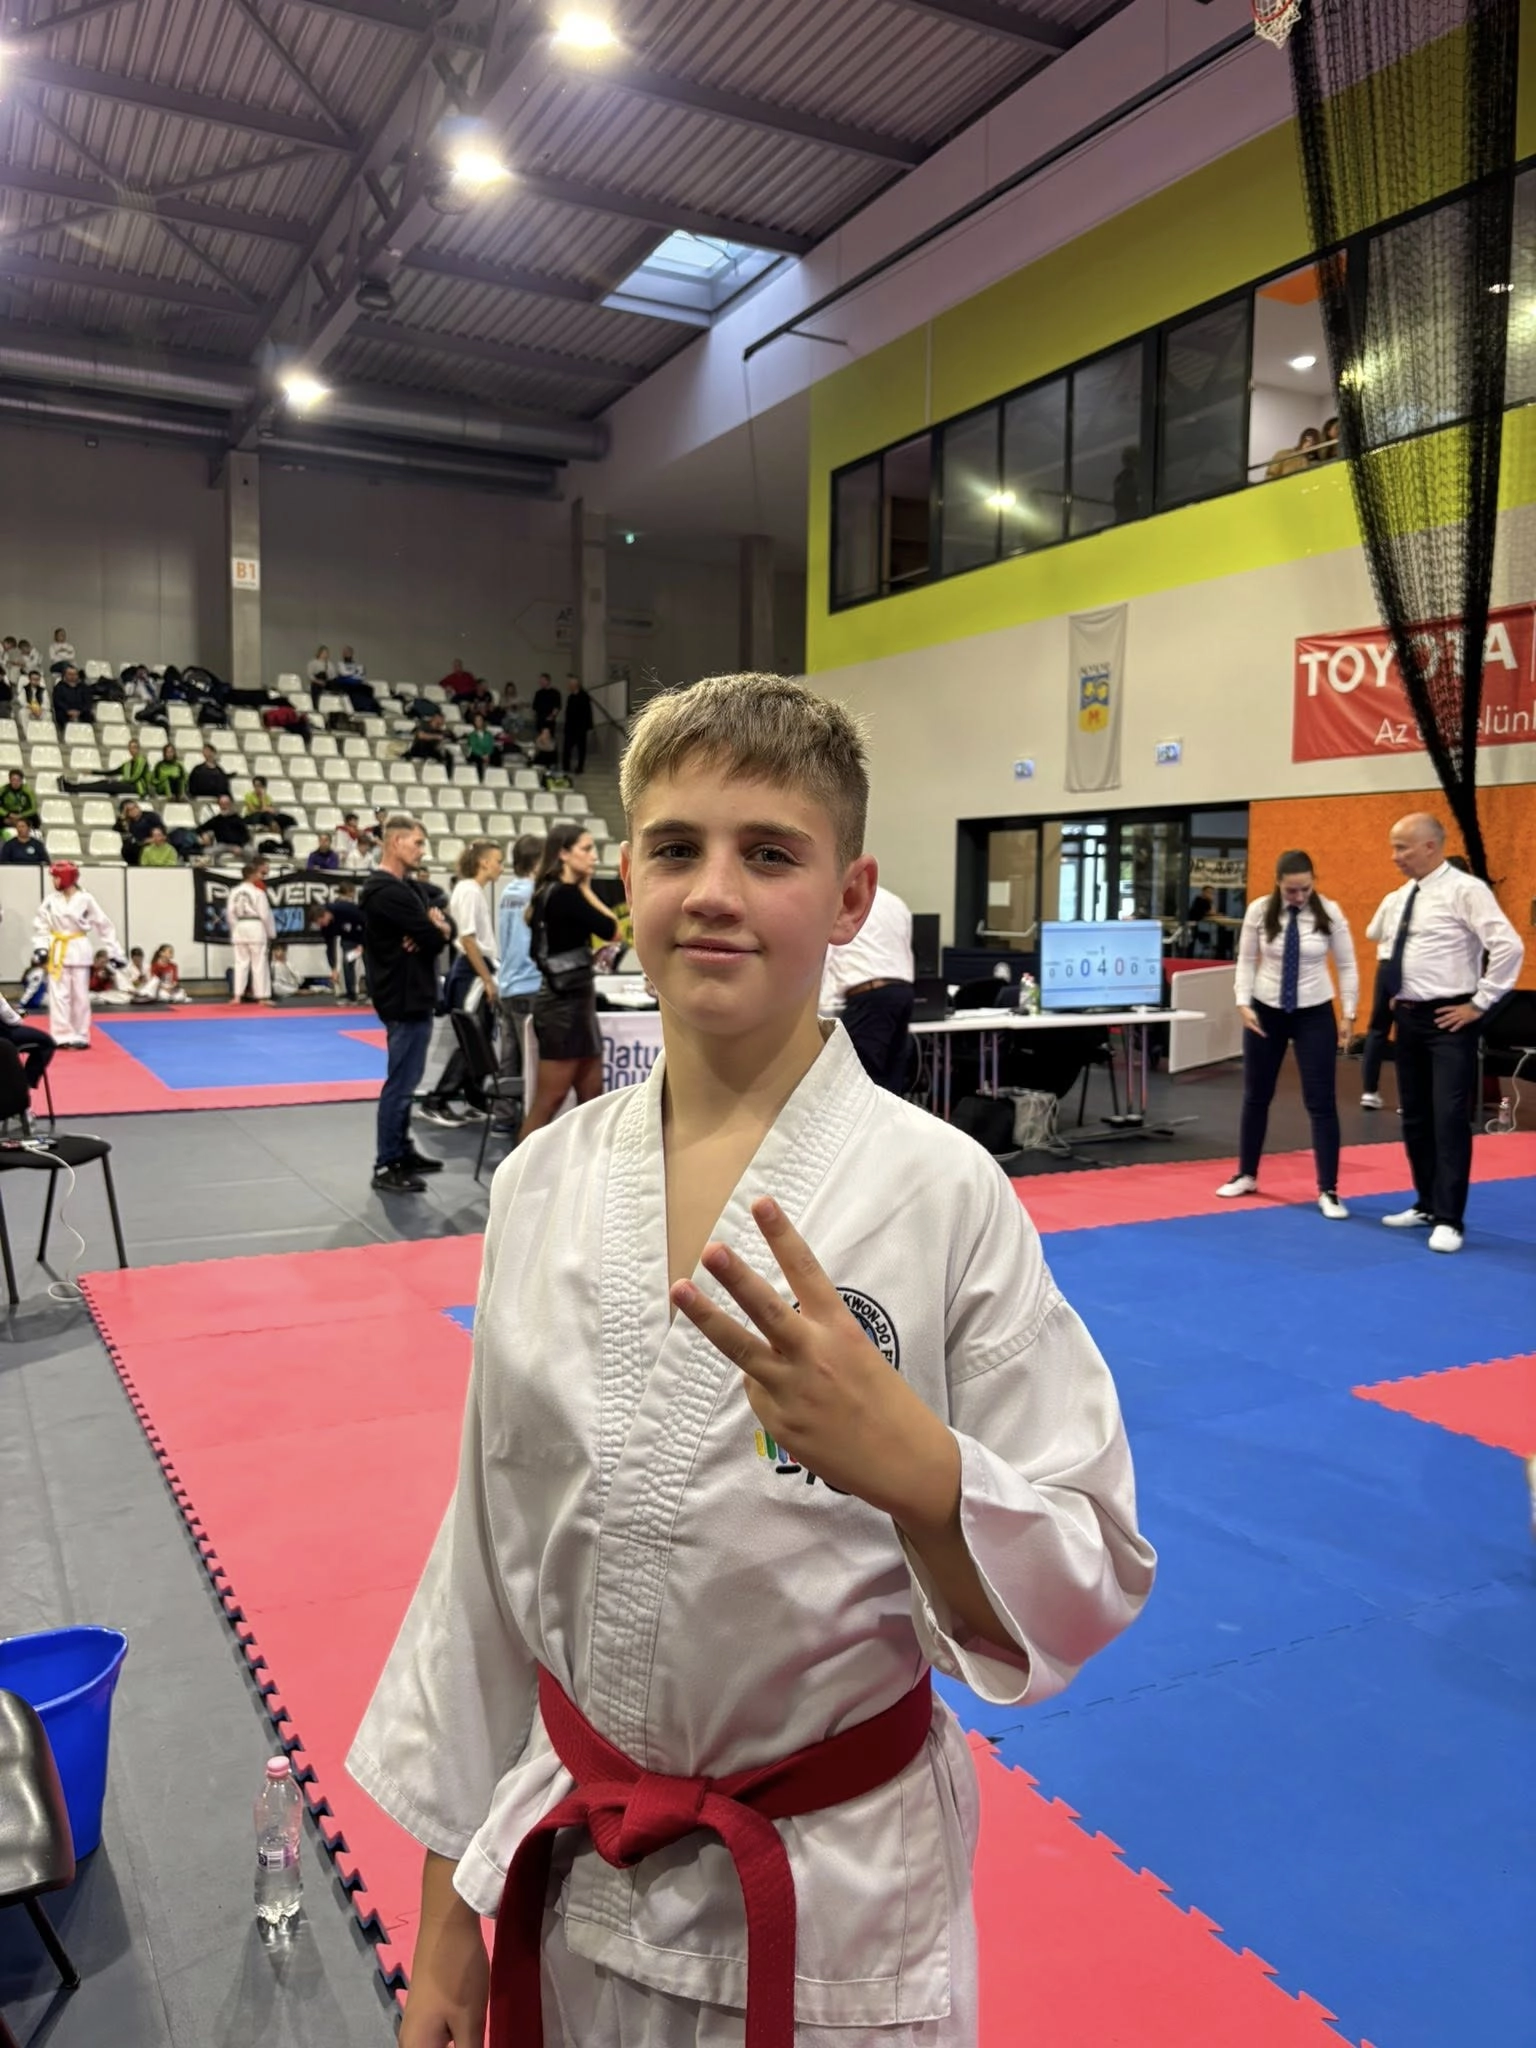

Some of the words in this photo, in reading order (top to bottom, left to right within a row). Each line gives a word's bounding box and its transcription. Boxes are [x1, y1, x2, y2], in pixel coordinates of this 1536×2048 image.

[236, 561, 256, 580] B1
[1374, 718, 1408, 745] Az
[841, 1292, 892, 1345] KWON-DO
